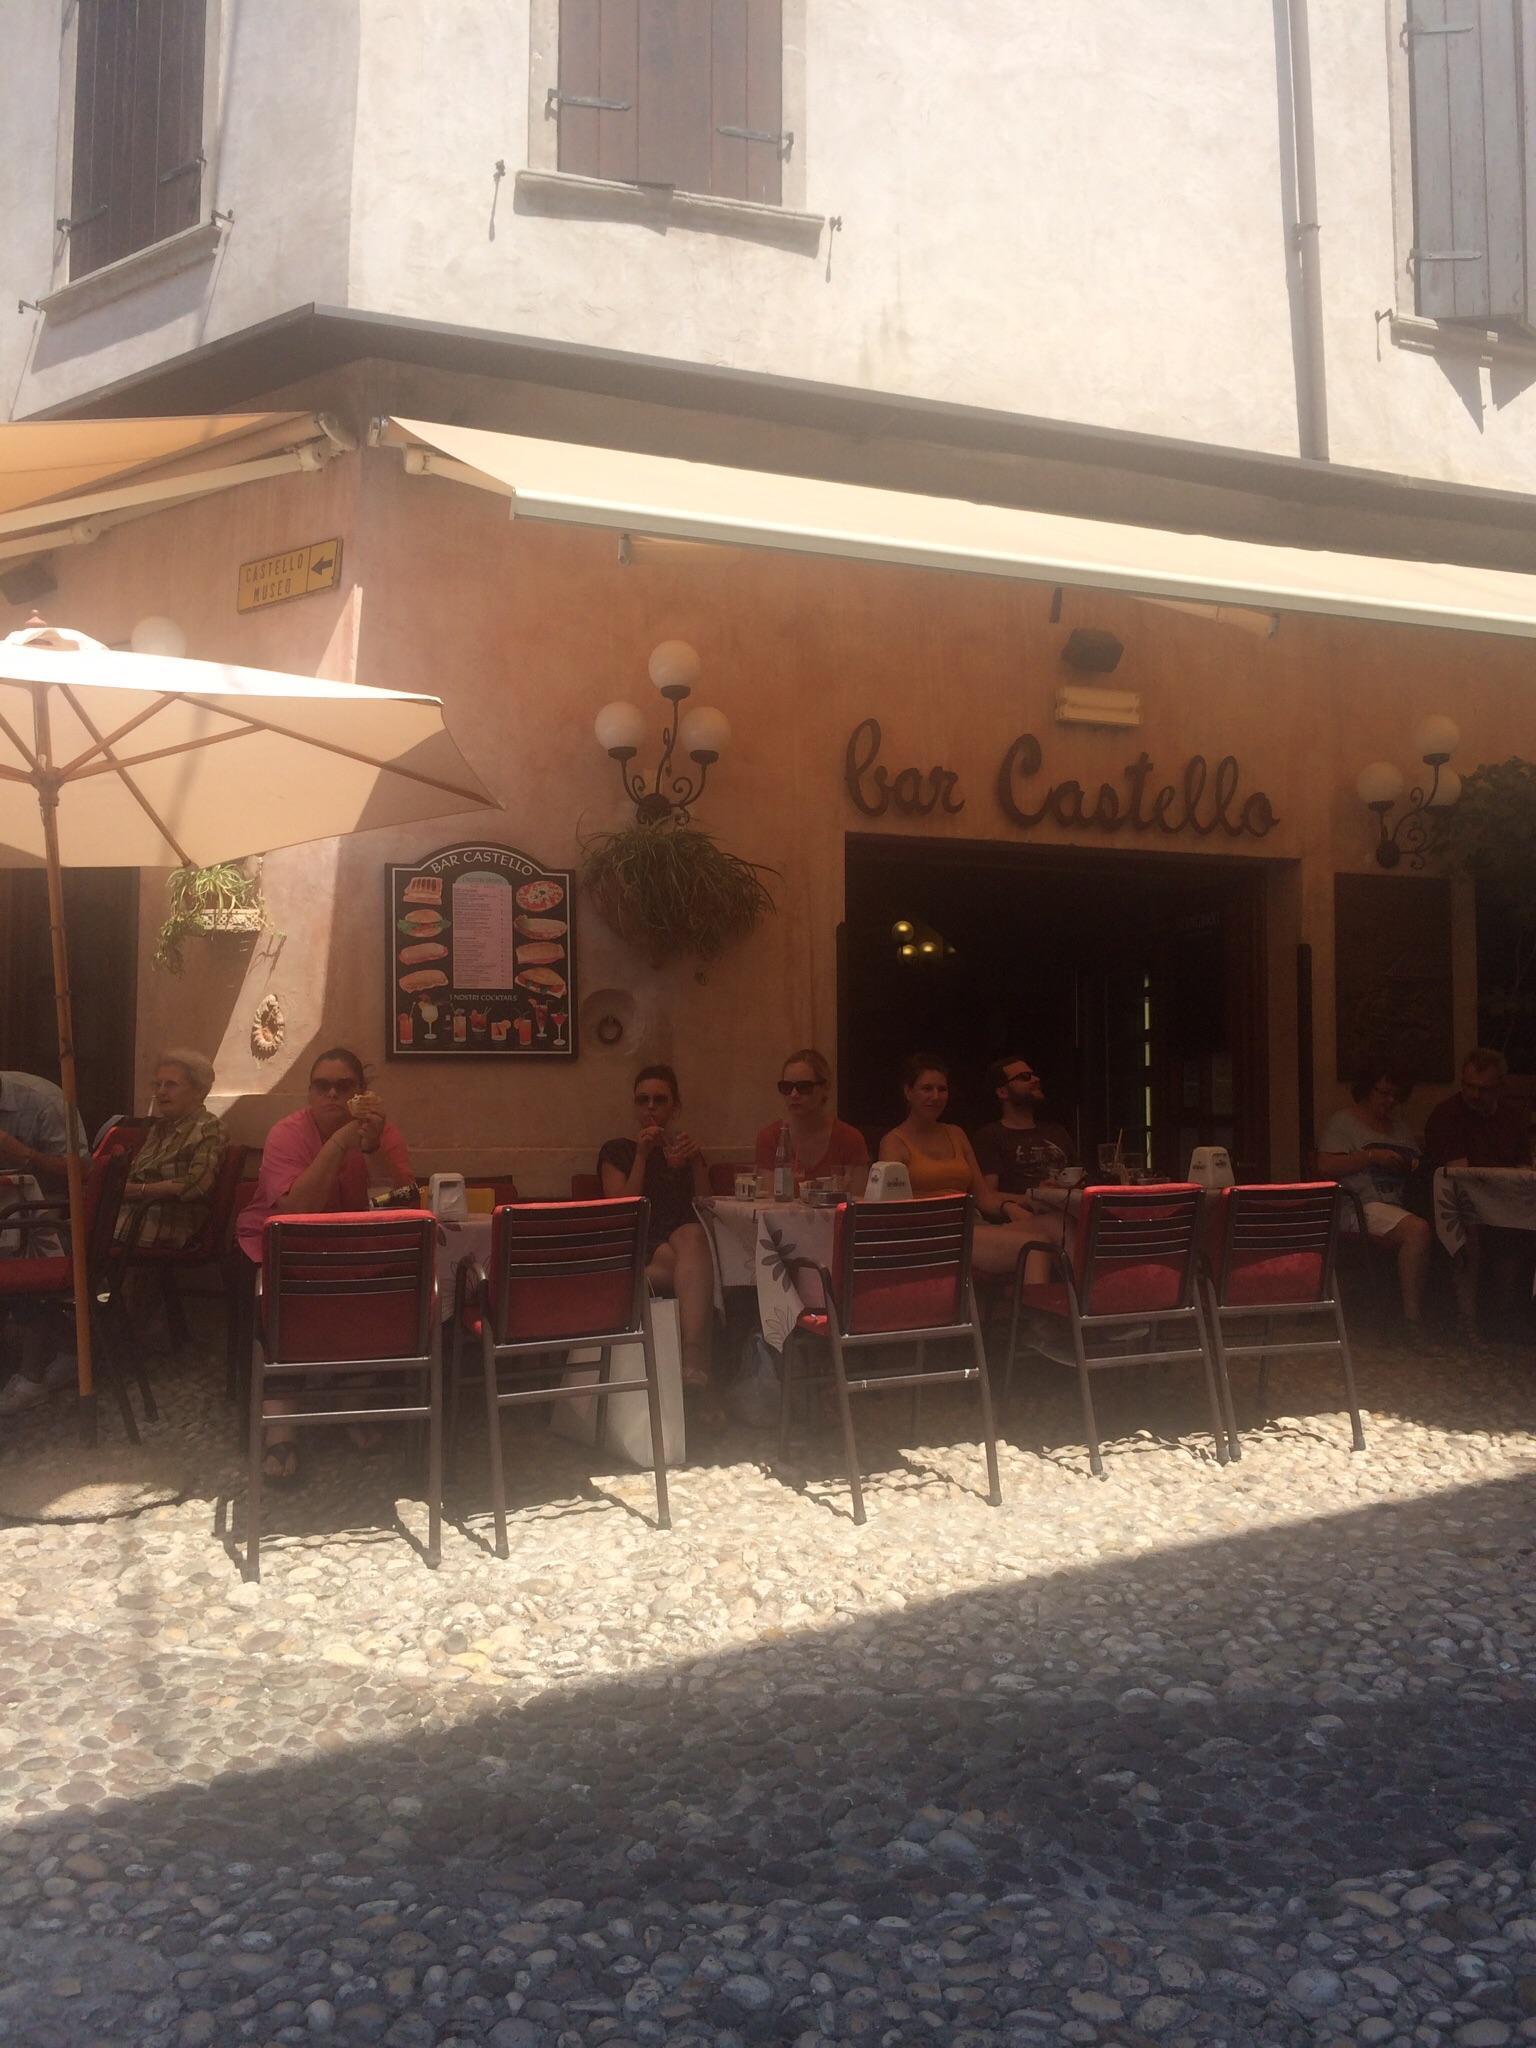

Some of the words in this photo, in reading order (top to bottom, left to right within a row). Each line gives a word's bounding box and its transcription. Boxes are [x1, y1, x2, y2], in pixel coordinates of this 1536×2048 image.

[246, 553, 304, 582] CASTELLO
[253, 578, 292, 601] MUSEO
[999, 733, 1281, 838] Castello
[430, 855, 460, 874] BAR
[463, 851, 533, 876] CASTELLO
